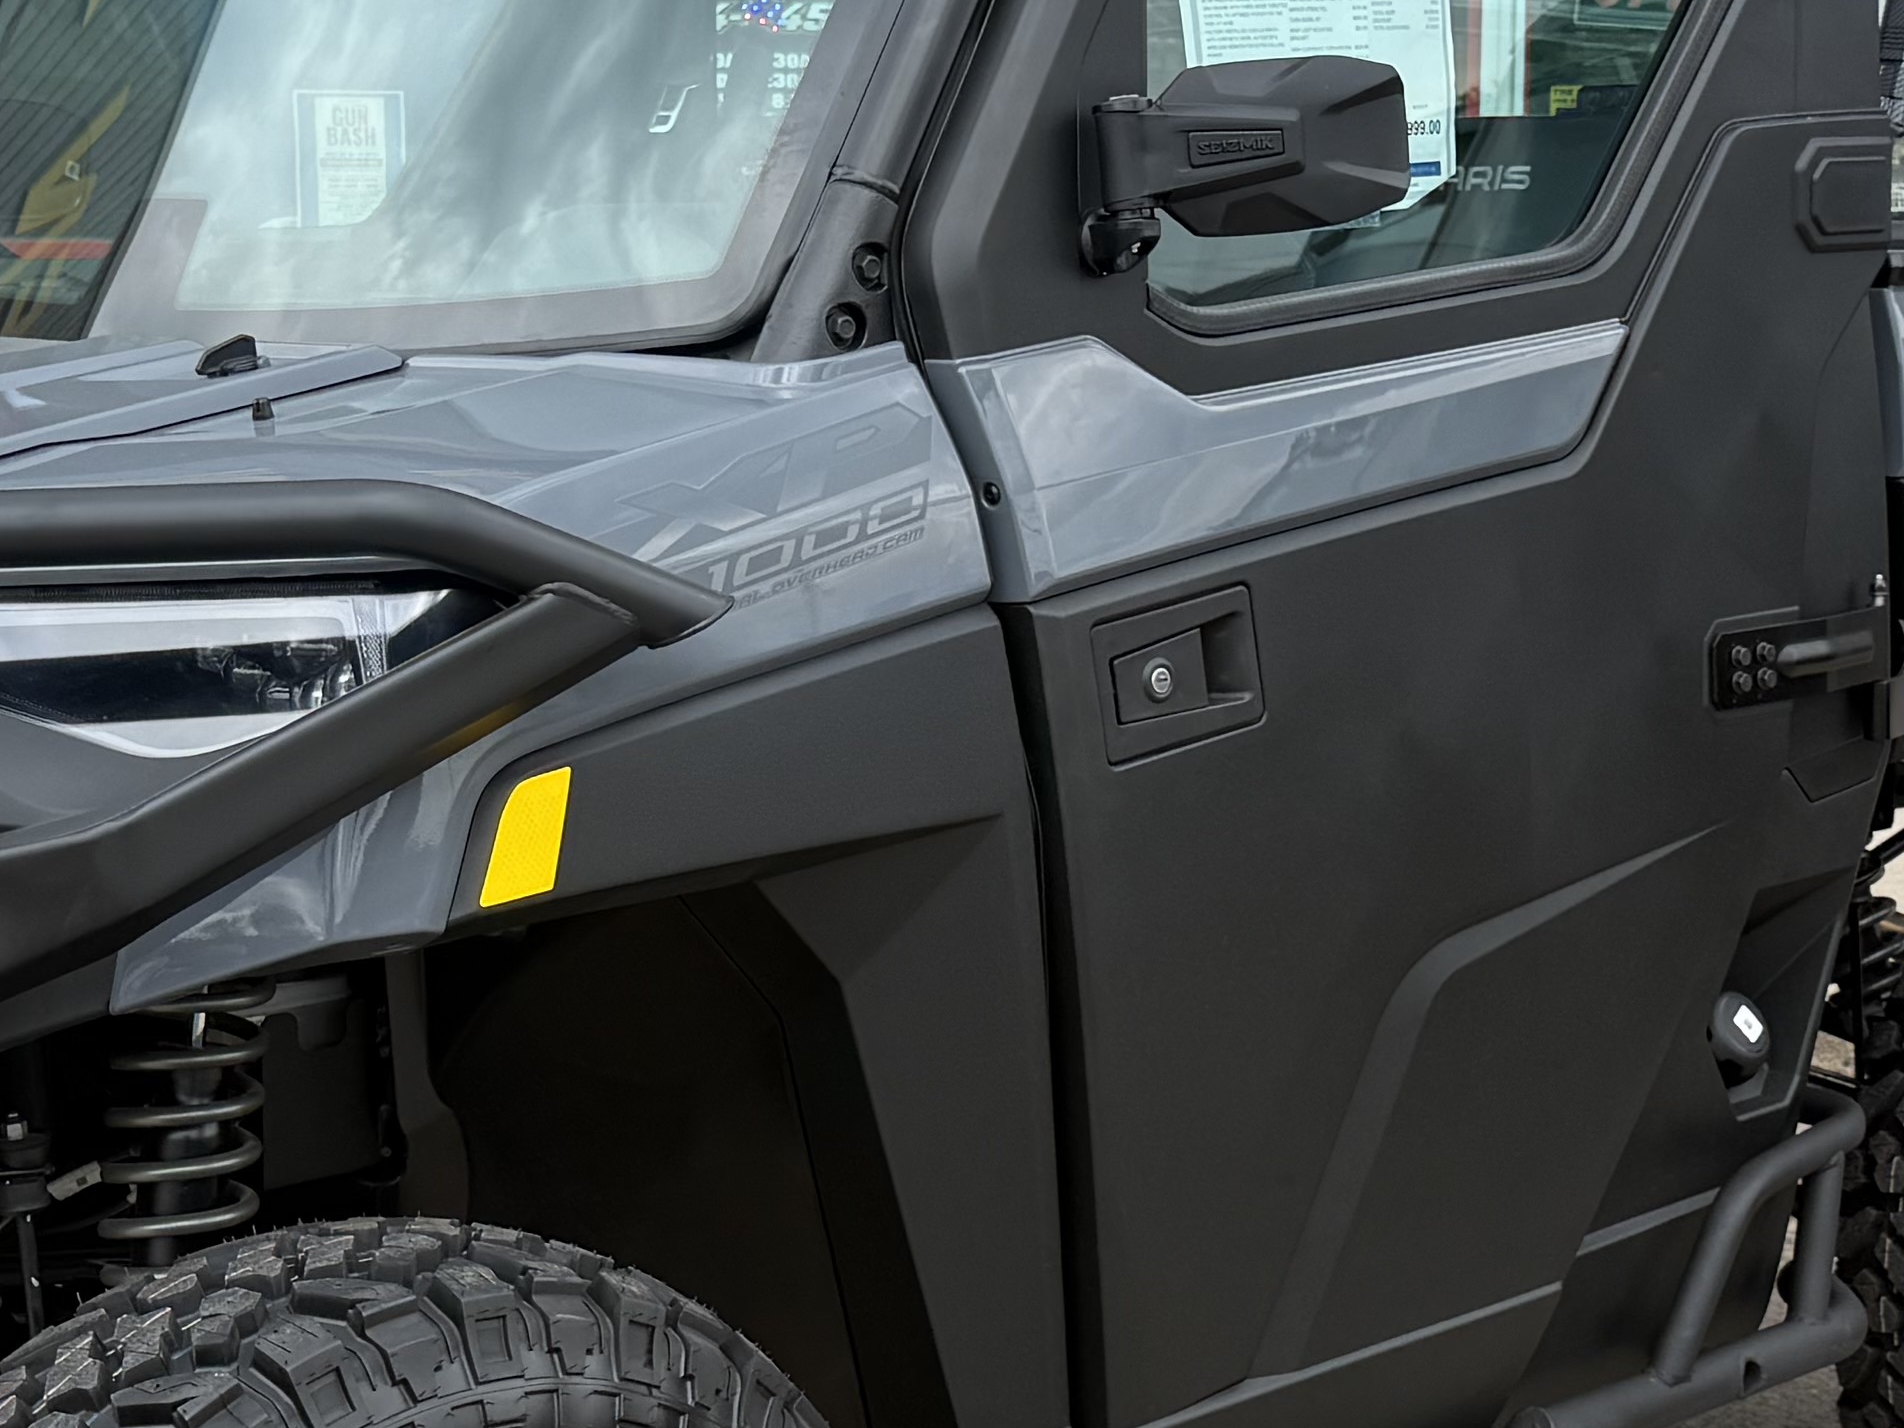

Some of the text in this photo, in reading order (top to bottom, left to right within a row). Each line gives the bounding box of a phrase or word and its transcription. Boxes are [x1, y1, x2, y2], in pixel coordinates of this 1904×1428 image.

[1197, 138, 1275, 156] SEIZMIK
[1441, 165, 1531, 192] ARIS
[614, 401, 924, 564] XP
[706, 481, 928, 593] 1000
[882, 527, 925, 551] CAM
